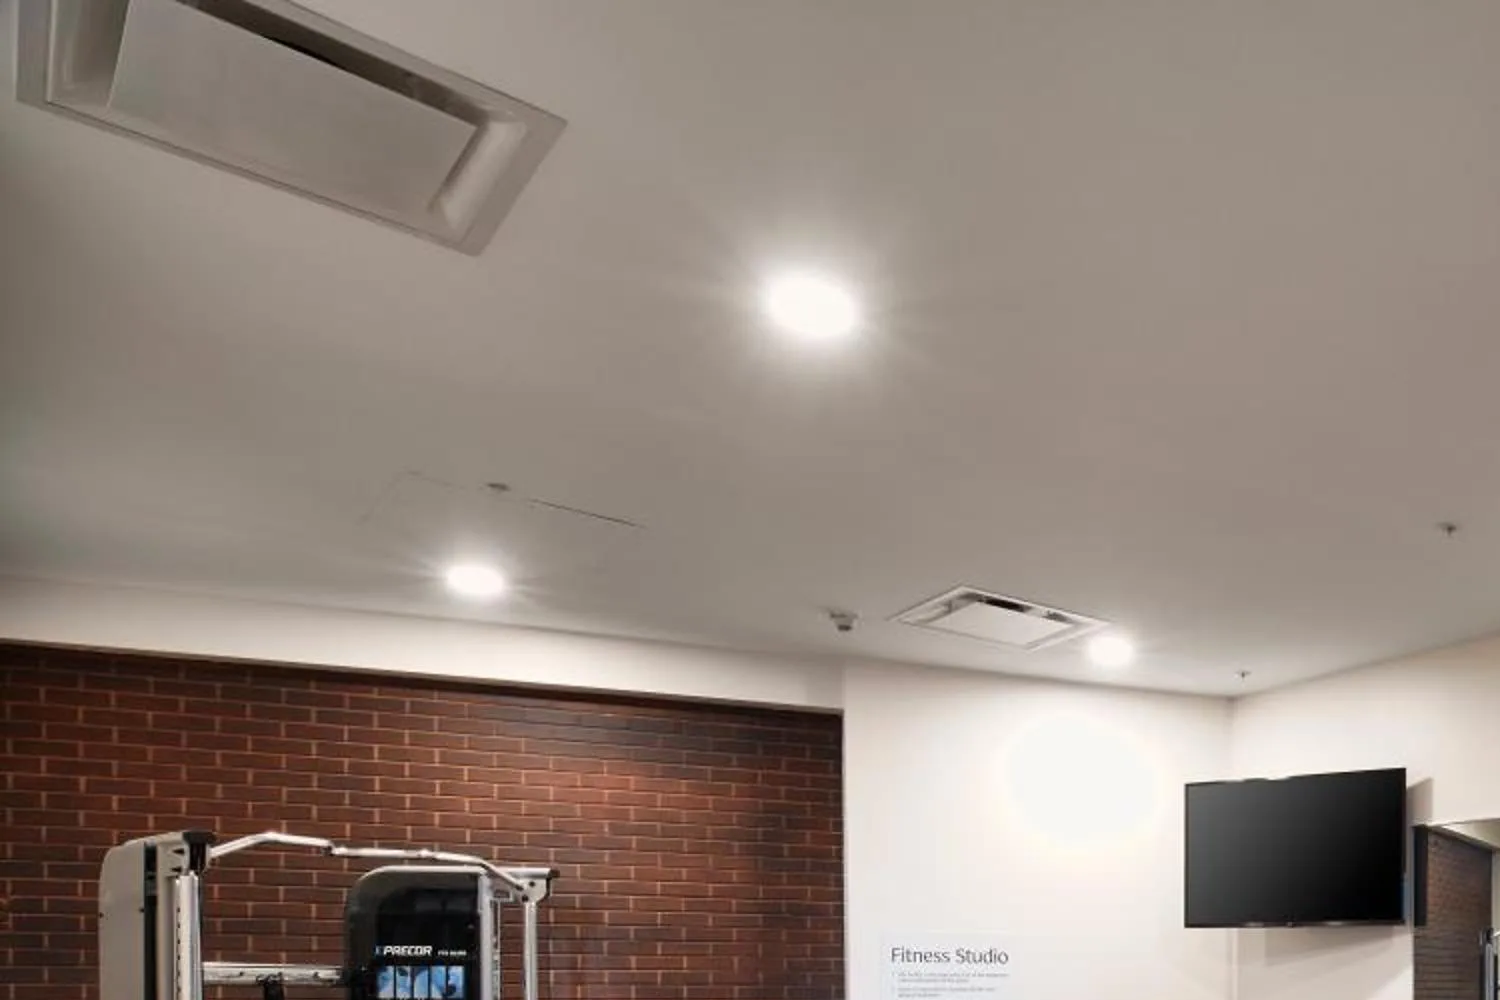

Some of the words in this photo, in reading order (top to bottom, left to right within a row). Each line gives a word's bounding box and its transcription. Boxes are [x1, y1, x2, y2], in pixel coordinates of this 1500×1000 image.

[383, 945, 433, 957] PRECOR
[891, 946, 951, 963] Fitness
[955, 946, 1009, 965] Studio
